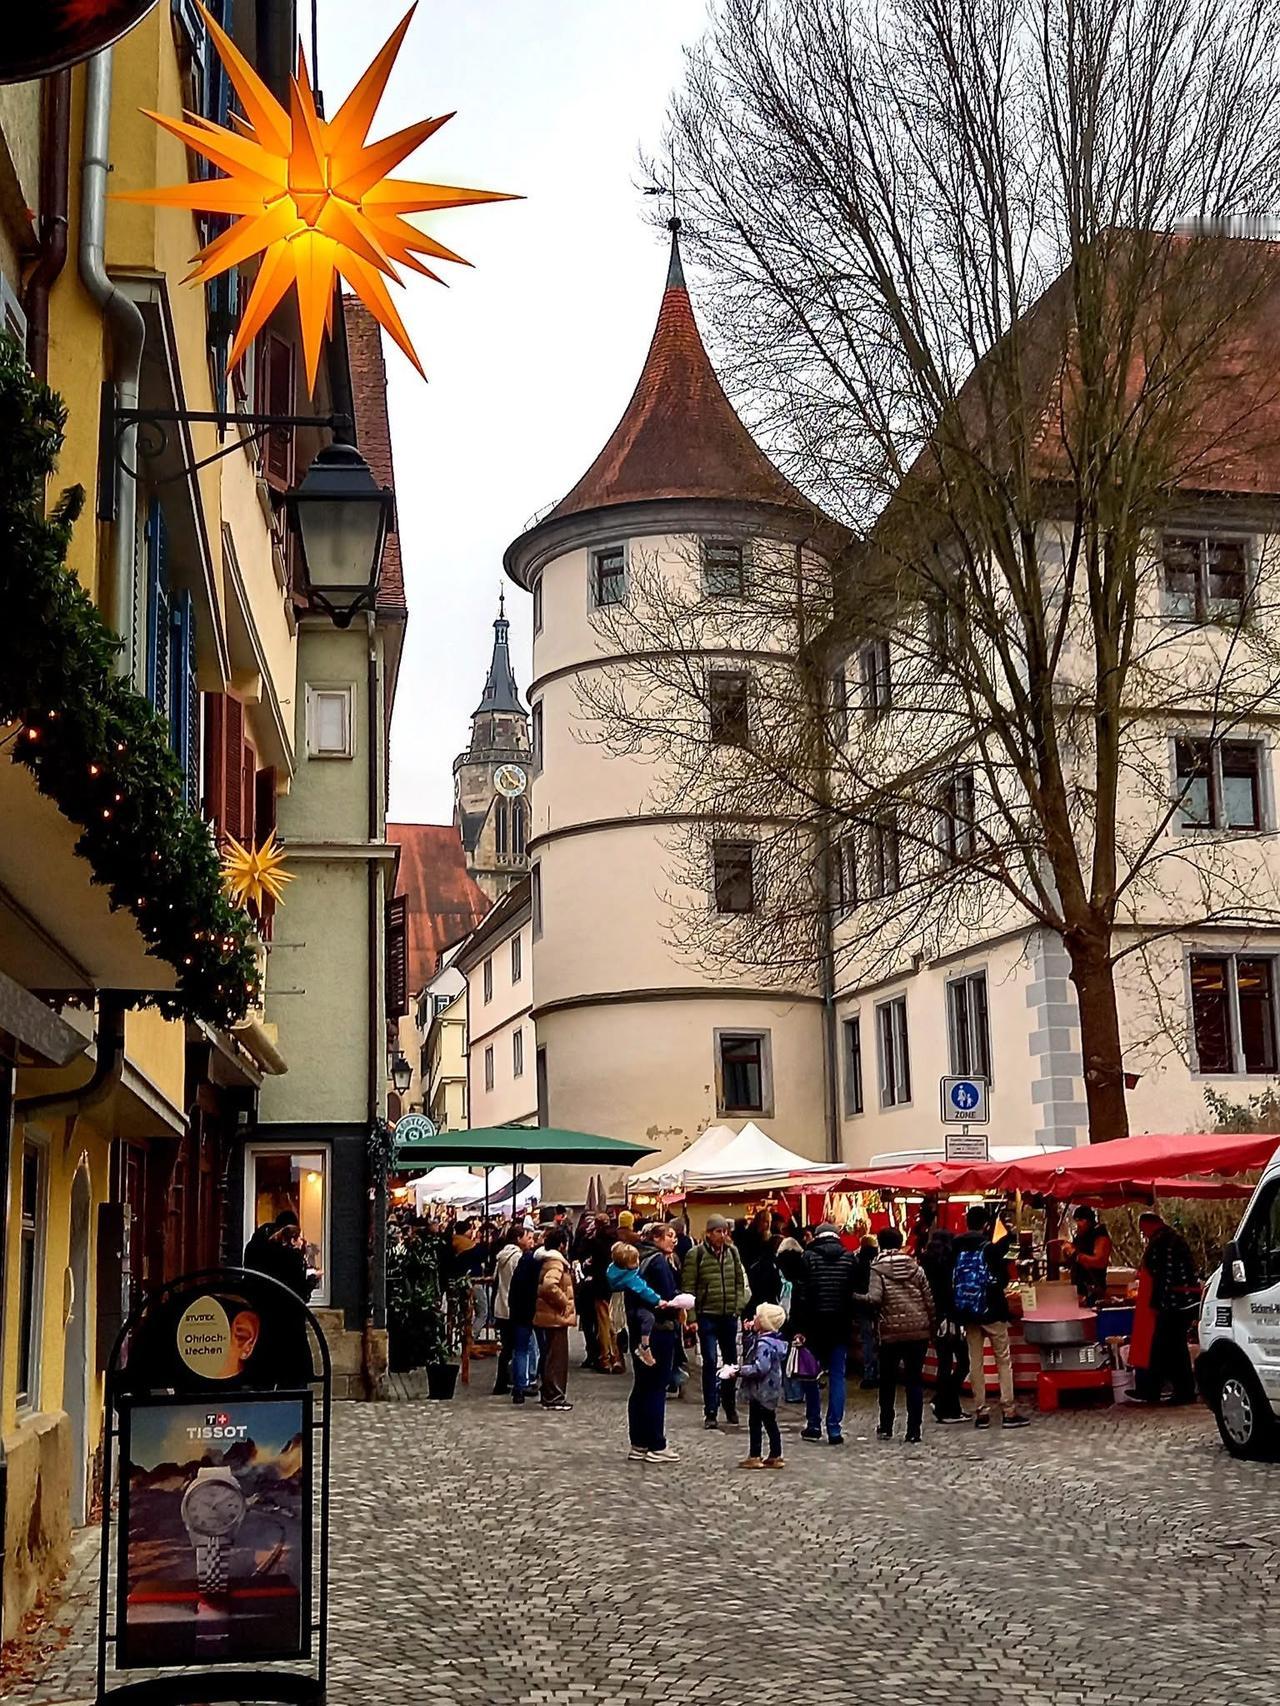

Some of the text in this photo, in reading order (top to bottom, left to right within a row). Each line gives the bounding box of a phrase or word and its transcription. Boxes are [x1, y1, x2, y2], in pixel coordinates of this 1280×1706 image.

[955, 1111, 976, 1119] ZONE
[185, 1334, 226, 1343] Ohrloch-
[184, 1346, 222, 1355] stechen
[186, 1426, 247, 1439] TISSOT
